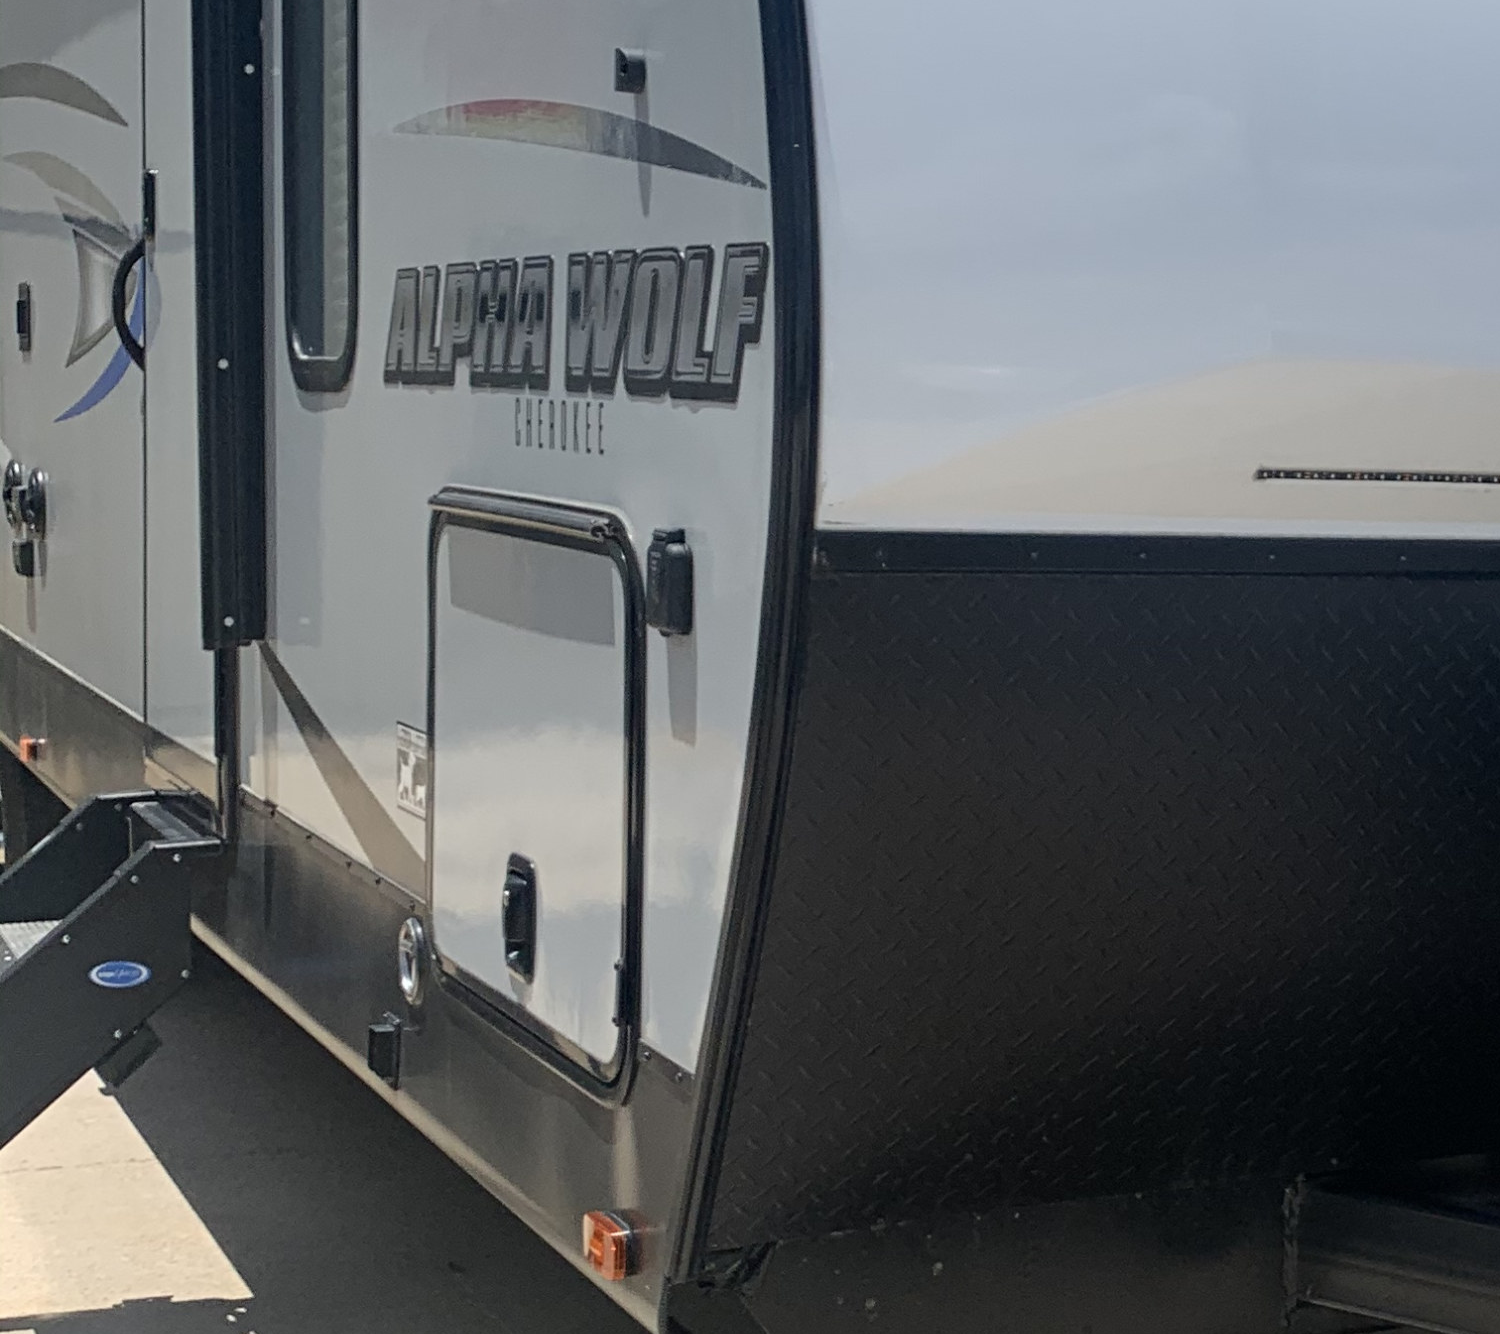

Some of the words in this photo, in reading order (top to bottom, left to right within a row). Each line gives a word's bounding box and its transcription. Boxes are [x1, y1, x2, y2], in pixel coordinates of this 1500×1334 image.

[383, 254, 555, 391] ALPHA
[564, 241, 770, 403] WOLF
[514, 396, 605, 456] CHEROKEE
